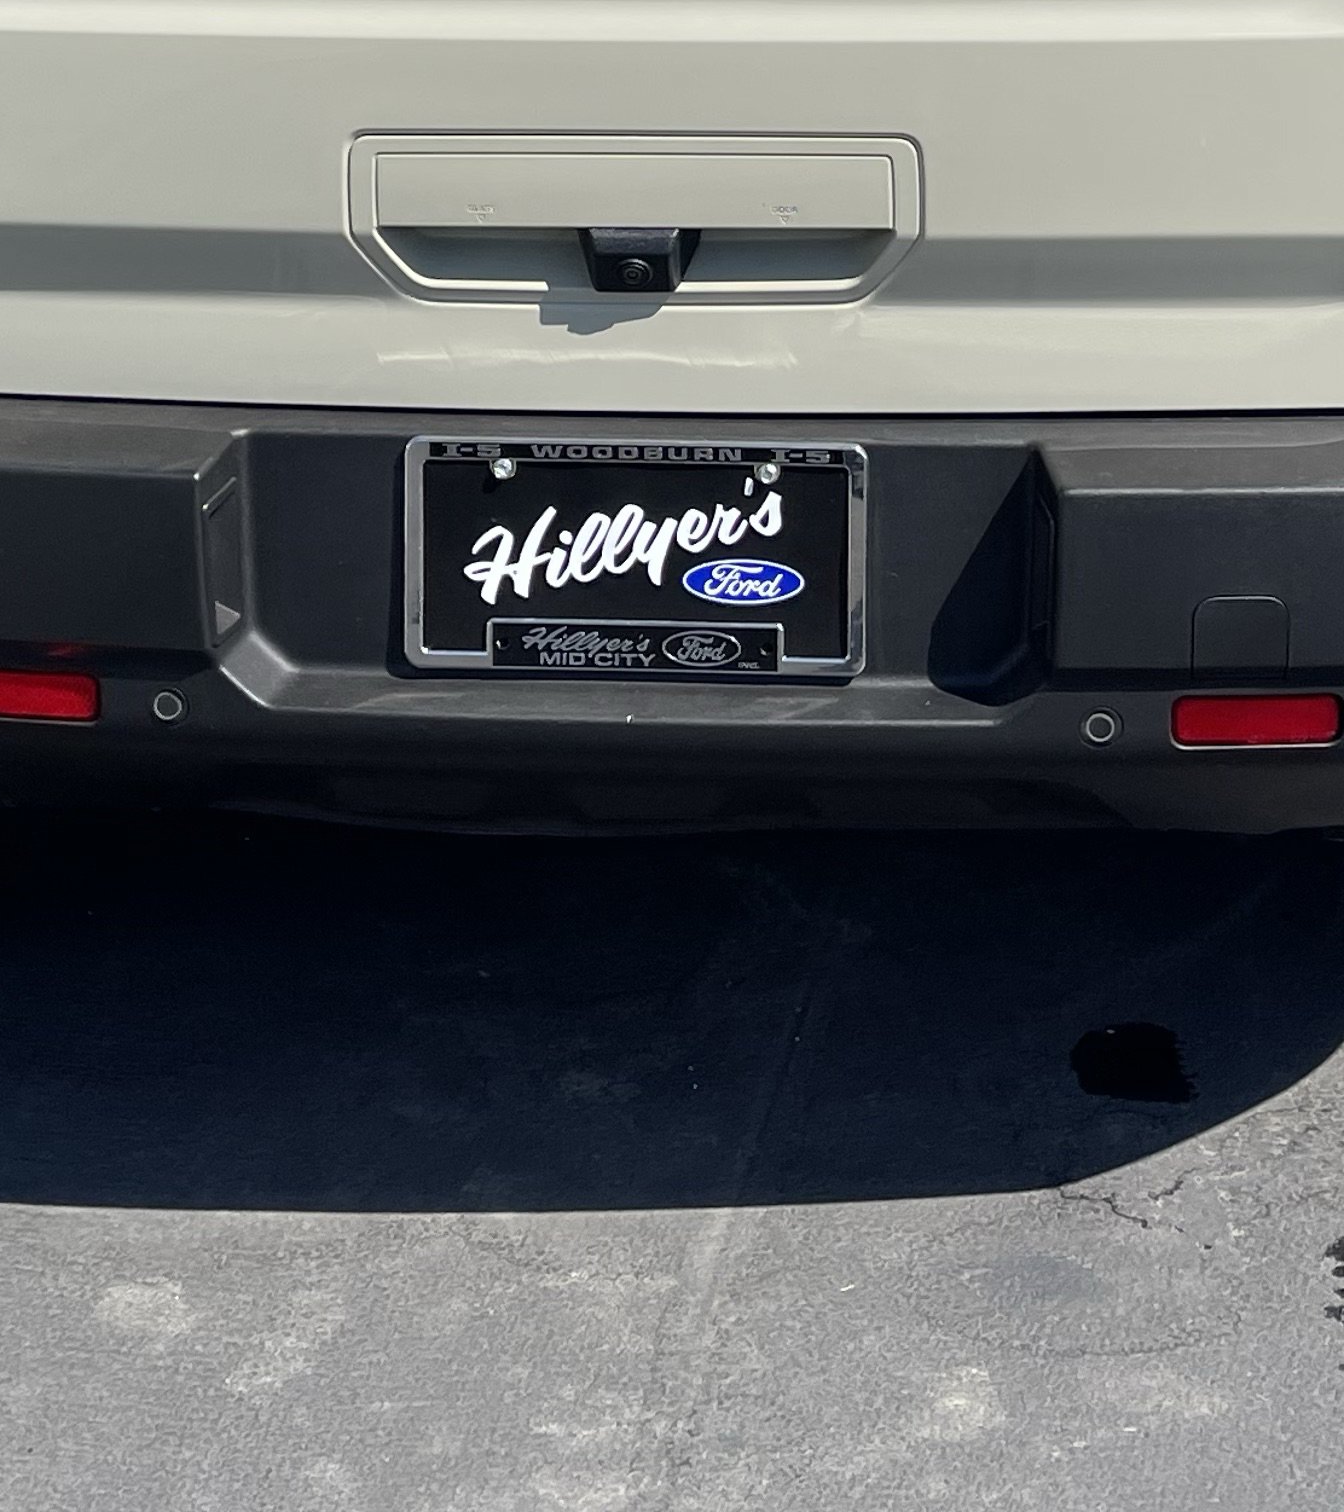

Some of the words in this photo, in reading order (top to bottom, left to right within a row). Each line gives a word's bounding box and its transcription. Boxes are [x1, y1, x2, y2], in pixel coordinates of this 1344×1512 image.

[442, 443, 502, 458] I-5
[529, 444, 743, 462] WOODBURN
[770, 448, 830, 464] I-5
[463, 476, 783, 605] Hillyer's
[702, 561, 783, 599] Ford
[521, 626, 651, 657] Hillyer's
[676, 635, 728, 661] Ford
